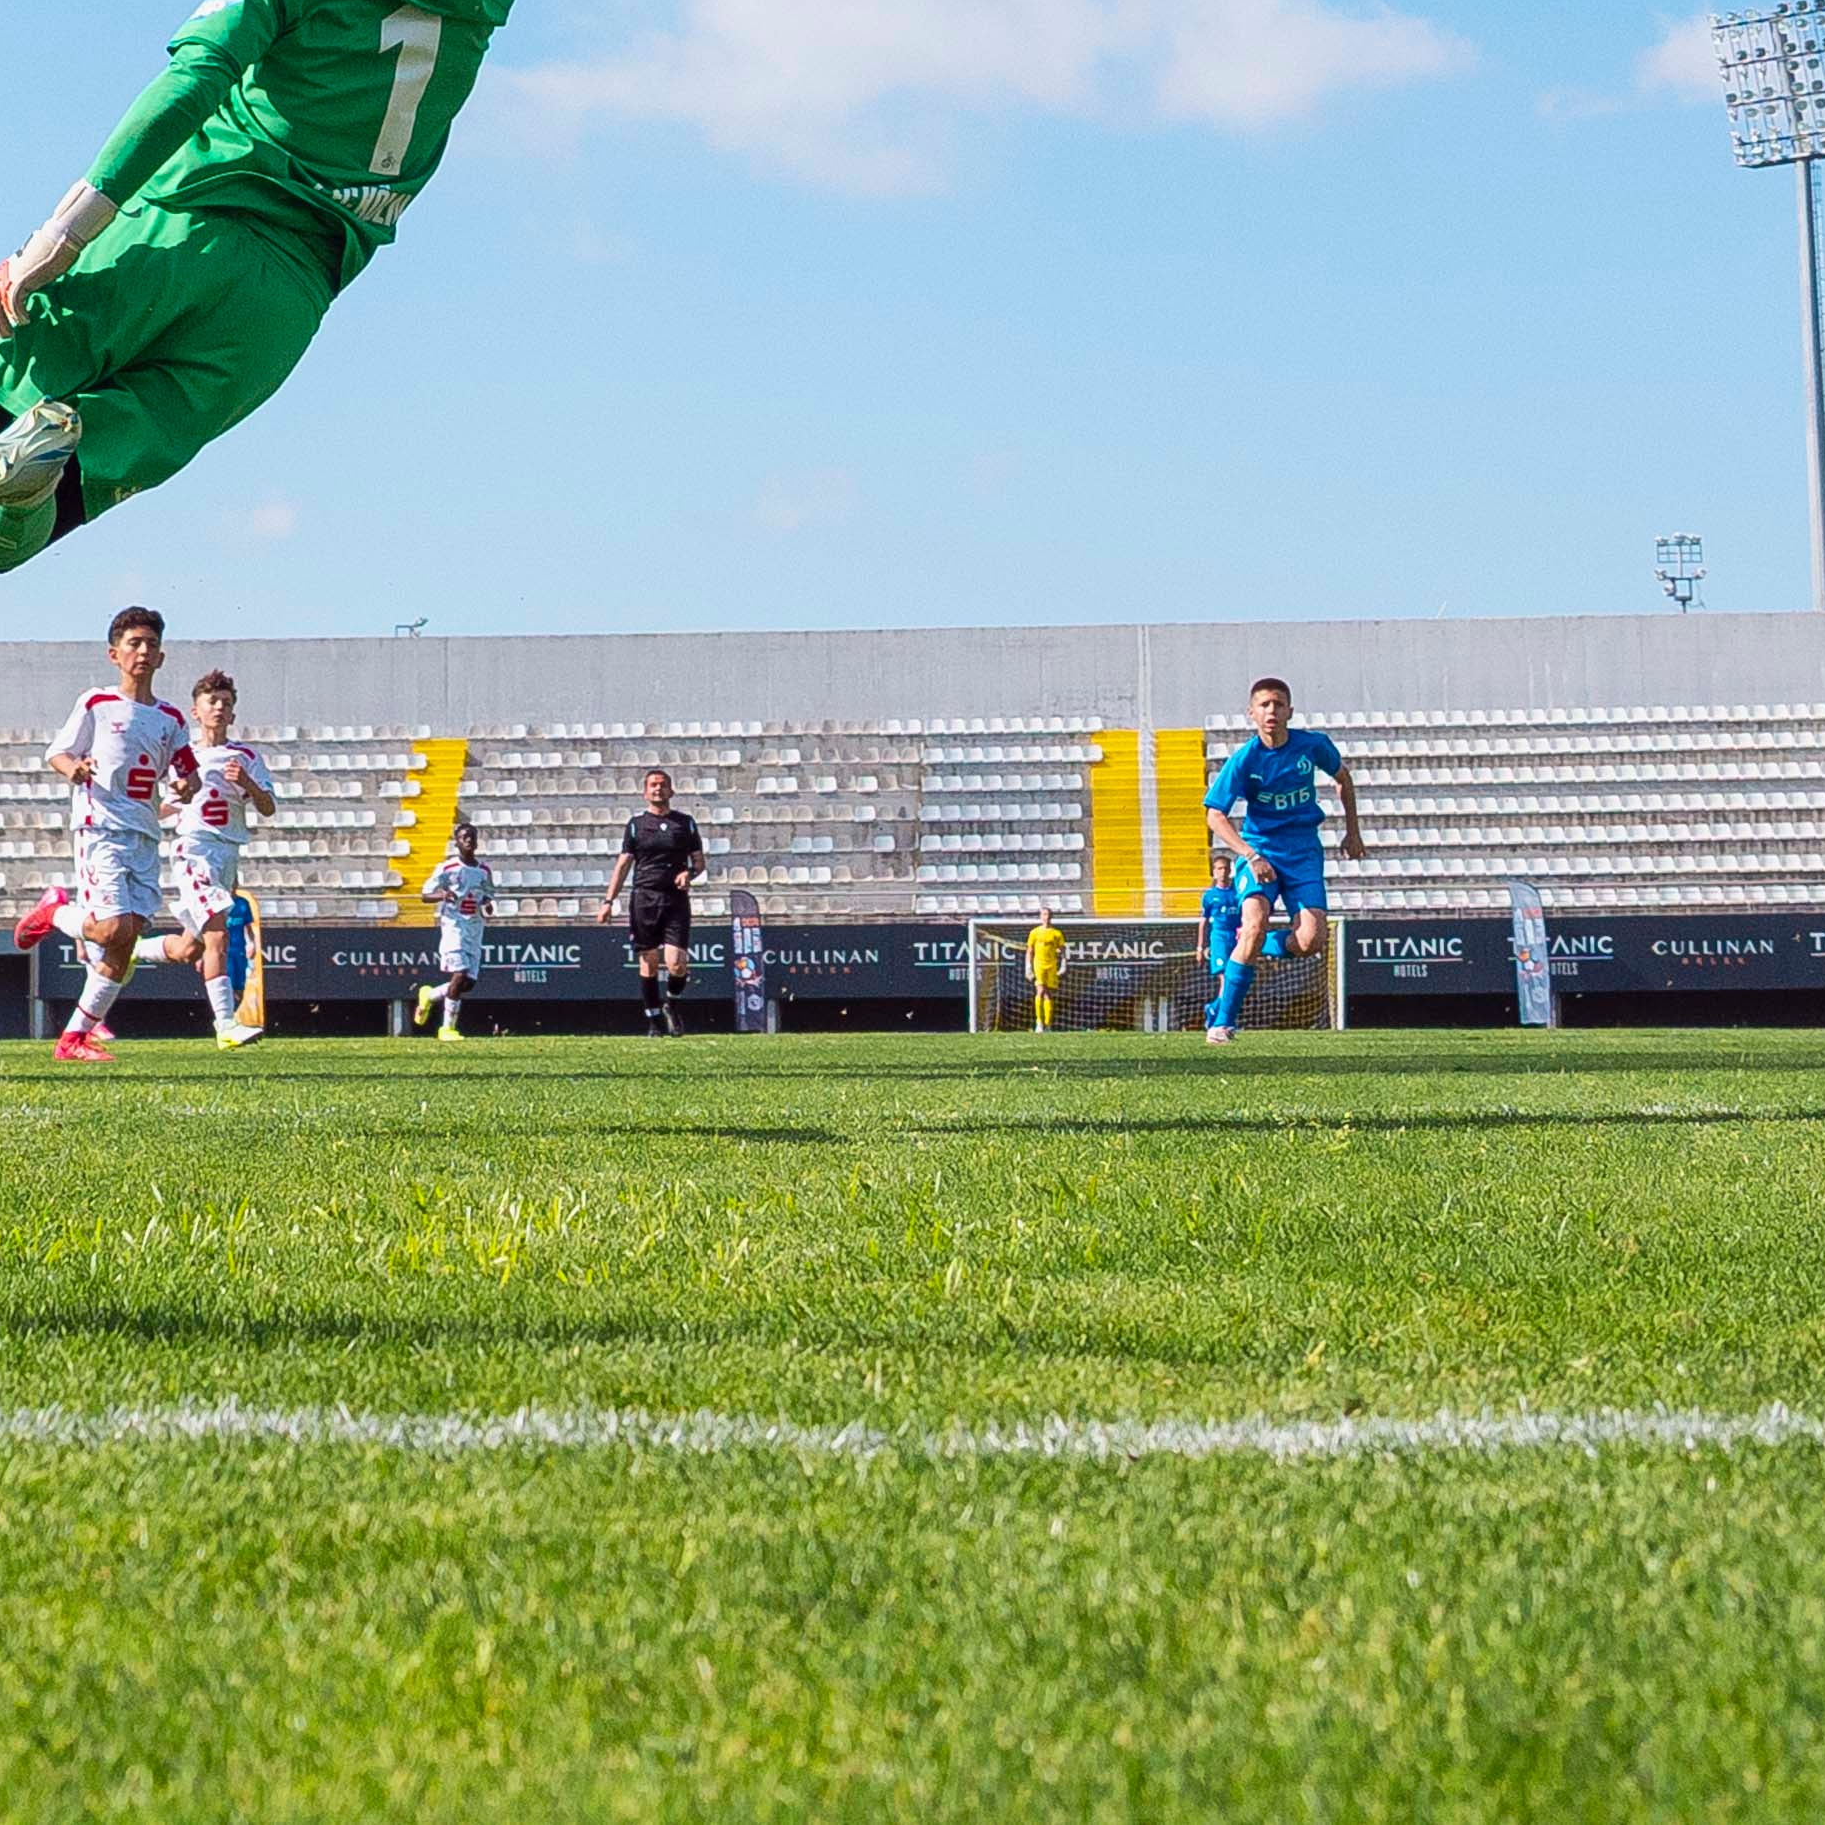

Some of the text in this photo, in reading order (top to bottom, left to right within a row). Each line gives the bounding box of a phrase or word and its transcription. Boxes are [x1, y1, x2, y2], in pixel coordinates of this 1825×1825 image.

[368, 4, 443, 176] 1
[481, 944, 581, 963] TITANIC
[1357, 936, 1463, 957] TITANIC
[1653, 939, 1774, 956] CULLINAN
[762, 949, 879, 965] CULLINAN
